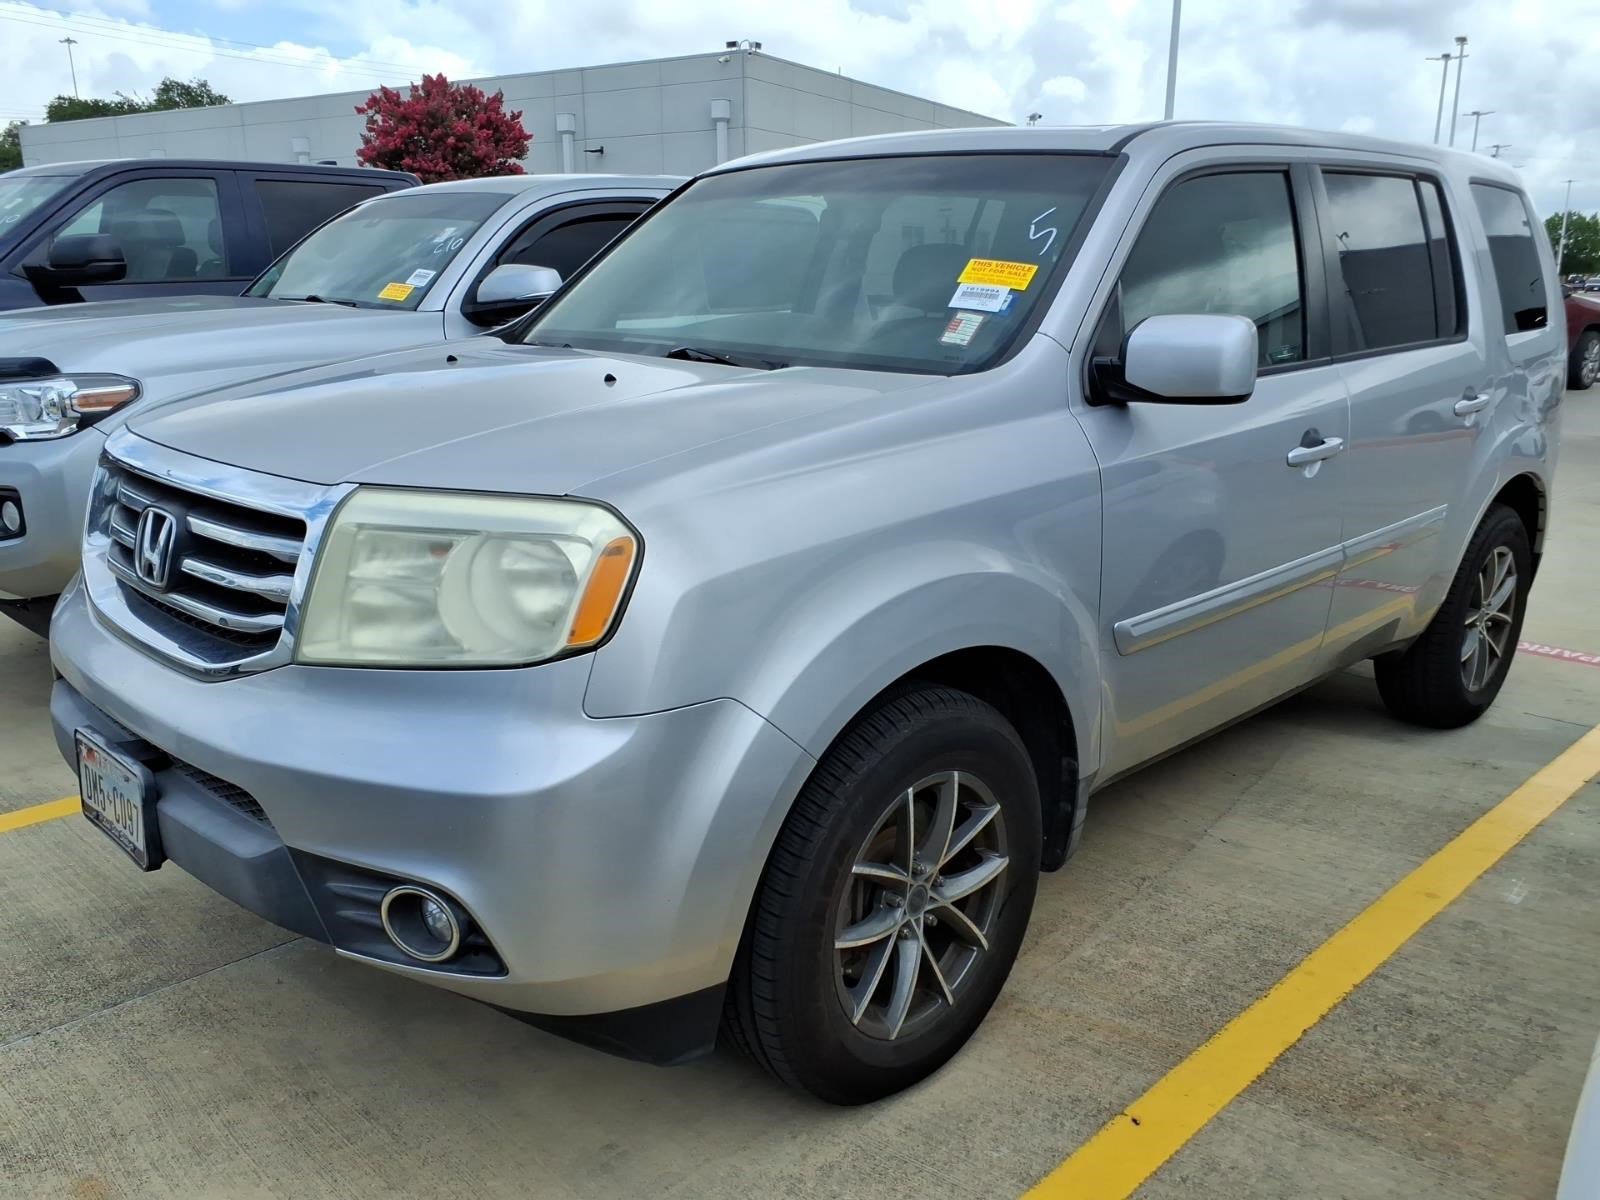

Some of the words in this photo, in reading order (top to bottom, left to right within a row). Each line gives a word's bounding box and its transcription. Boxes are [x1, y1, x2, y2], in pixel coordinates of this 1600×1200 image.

[1029, 207, 1057, 256] 5
[972, 260, 993, 268] THIS
[995, 262, 1034, 272] VEHICLE
